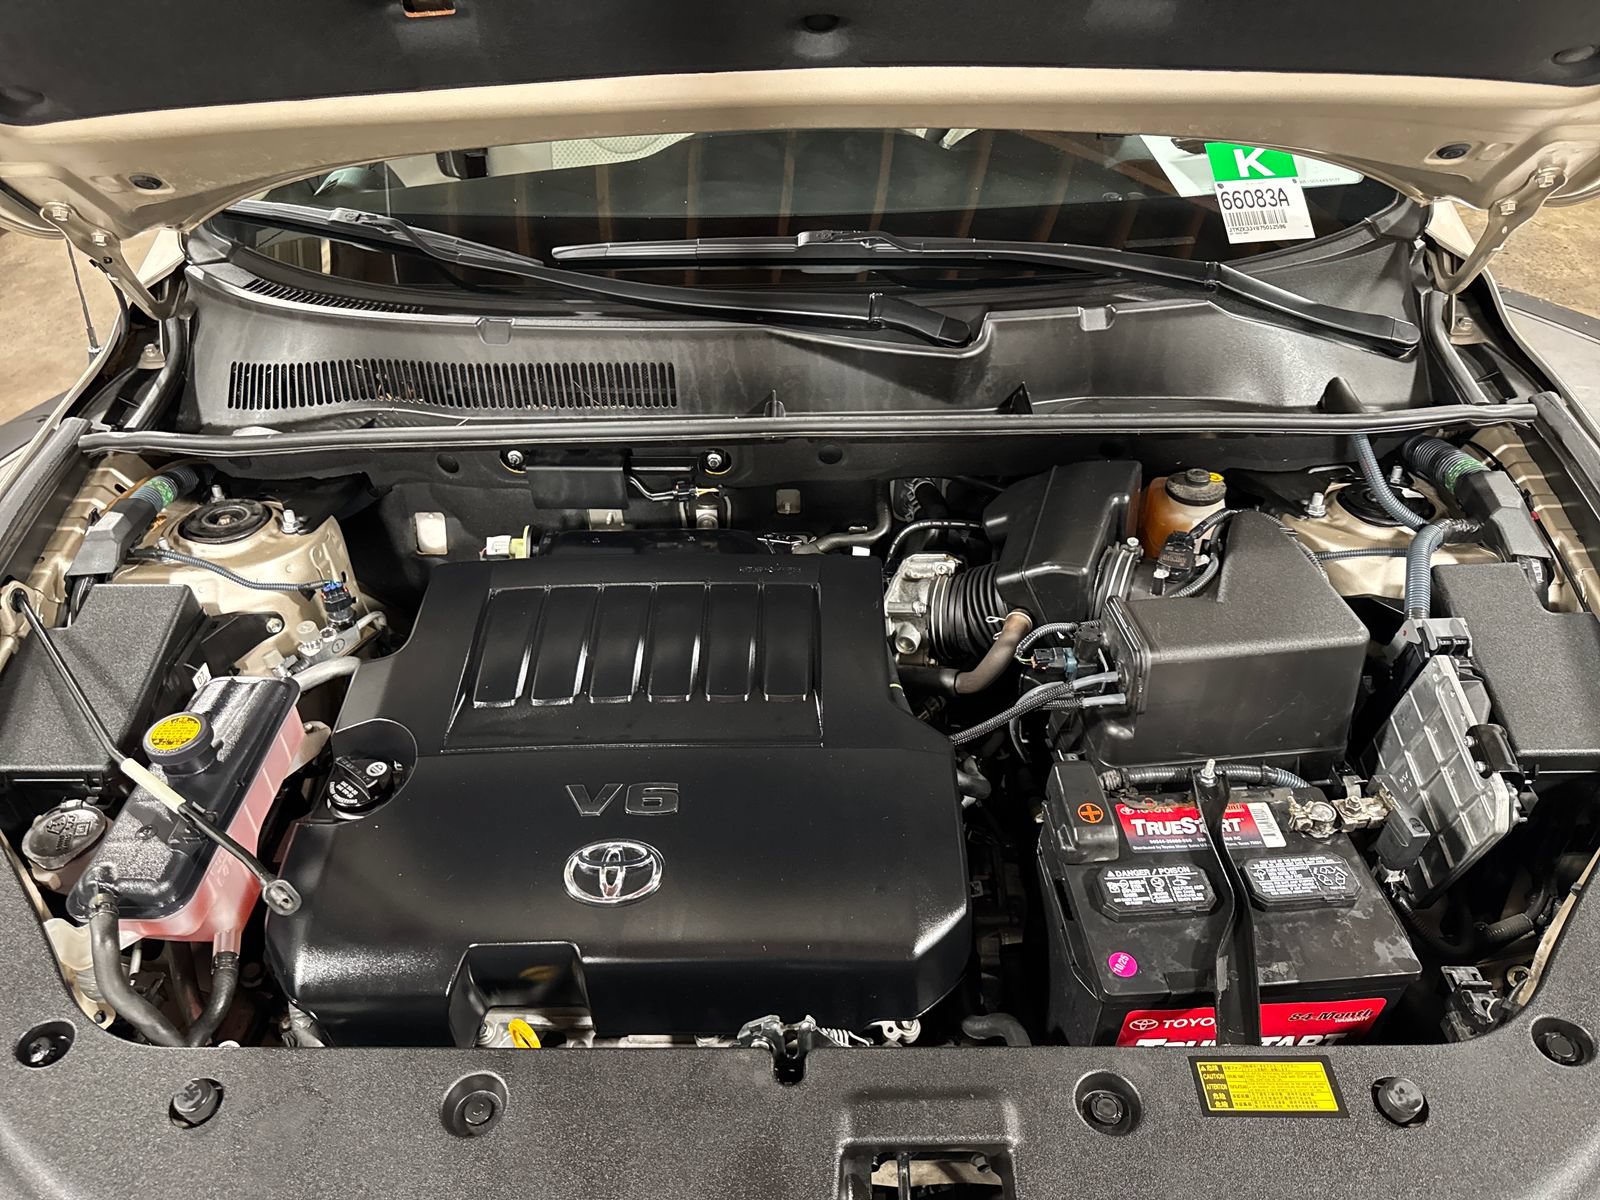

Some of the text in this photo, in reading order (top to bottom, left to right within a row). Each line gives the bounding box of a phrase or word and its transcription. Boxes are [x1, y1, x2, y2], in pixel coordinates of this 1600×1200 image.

[1233, 148, 1276, 177] K
[1220, 188, 1290, 210] 66083A
[565, 782, 680, 816] V6
[1115, 869, 1150, 877] DANGER
[1158, 866, 1190, 875] POISON
[1113, 954, 1129, 973] 10/25
[1163, 1017, 1216, 1029] TOYO
